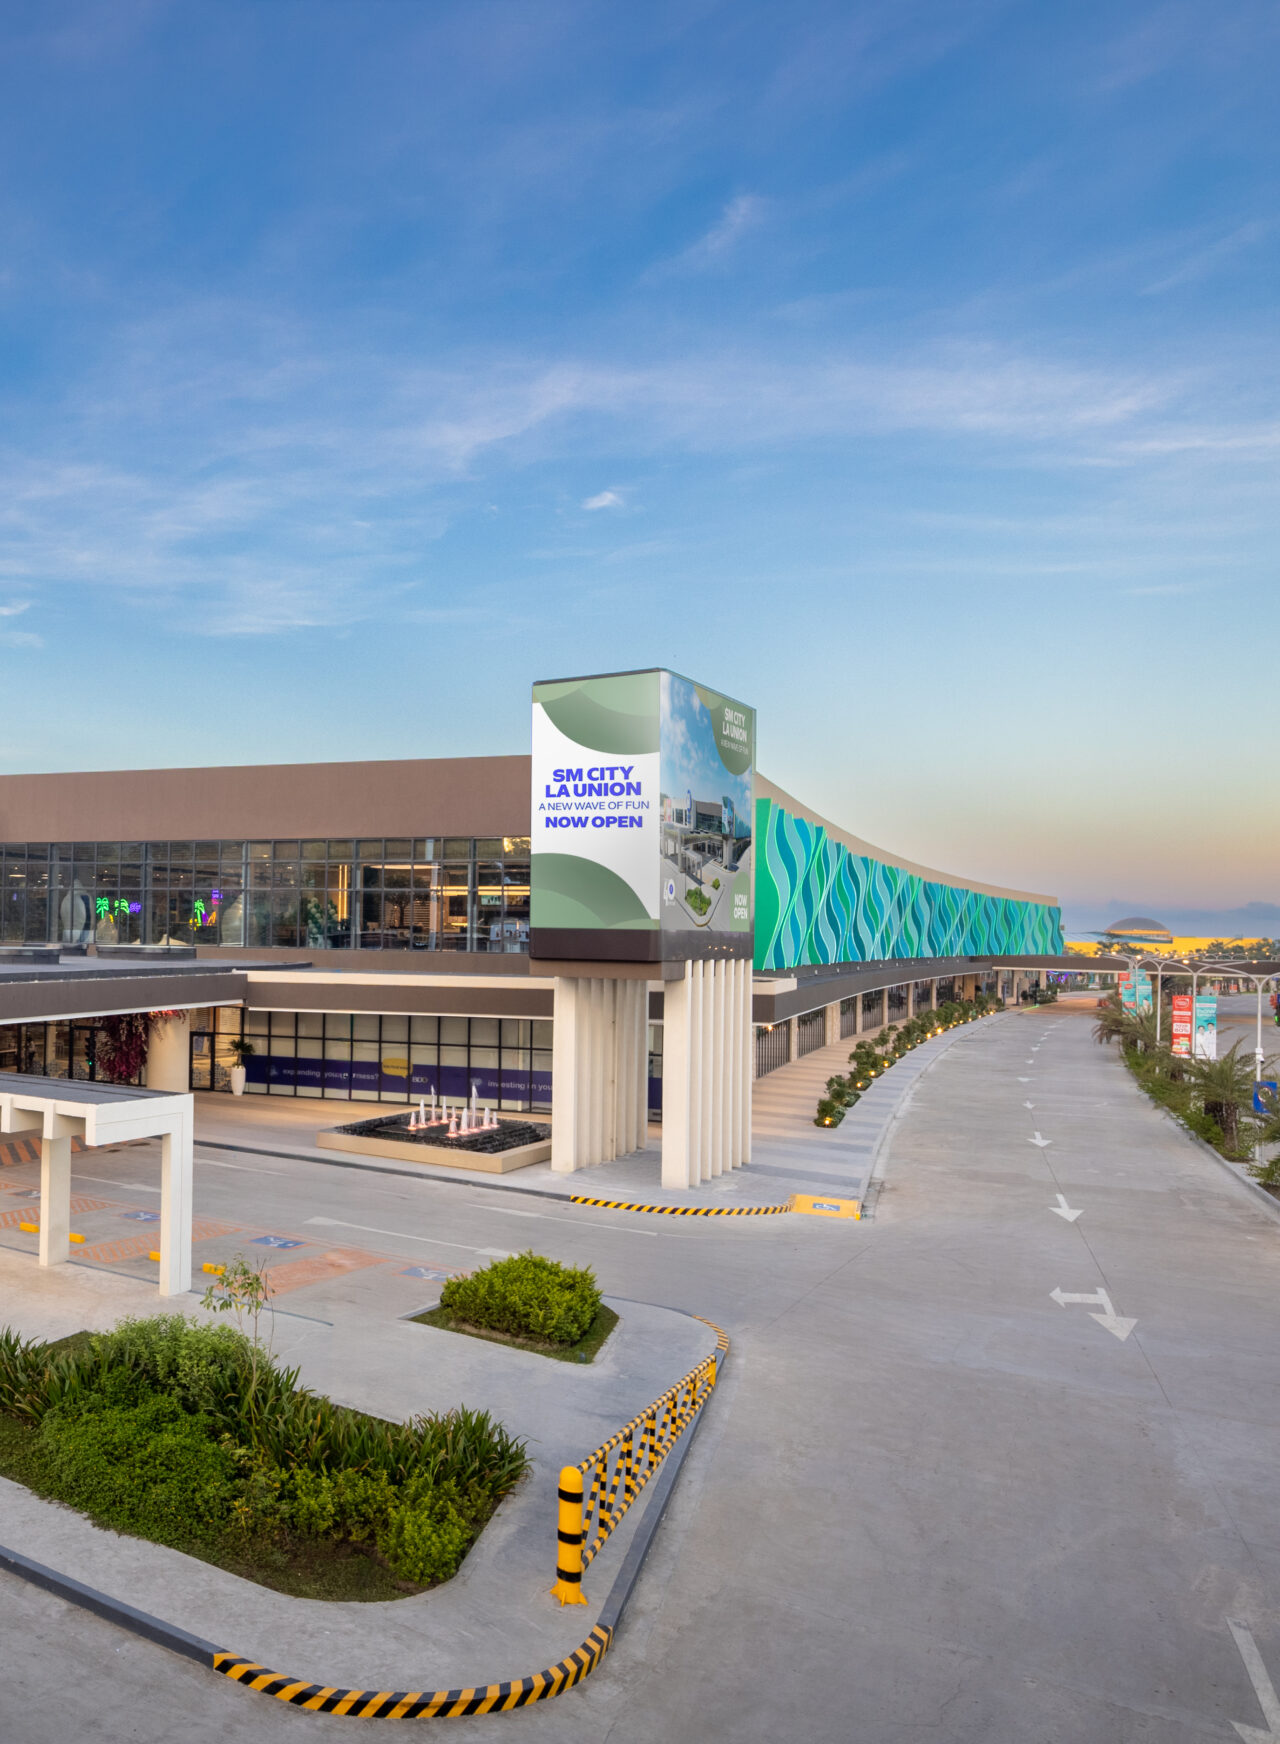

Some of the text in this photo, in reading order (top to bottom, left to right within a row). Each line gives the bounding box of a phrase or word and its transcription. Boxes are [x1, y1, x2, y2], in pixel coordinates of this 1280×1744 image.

[724, 706, 745, 727] SM CITY
[722, 721, 747, 742] LA UNION
[552, 766, 634, 782] SM CITY
[545, 782, 642, 798] LA UNION
[539, 801, 650, 811] A NEW WAVE OF FUN
[545, 816, 643, 828] NOW OPEN
[734, 894, 748, 906] NOW
[733, 907, 748, 919] OPEN
